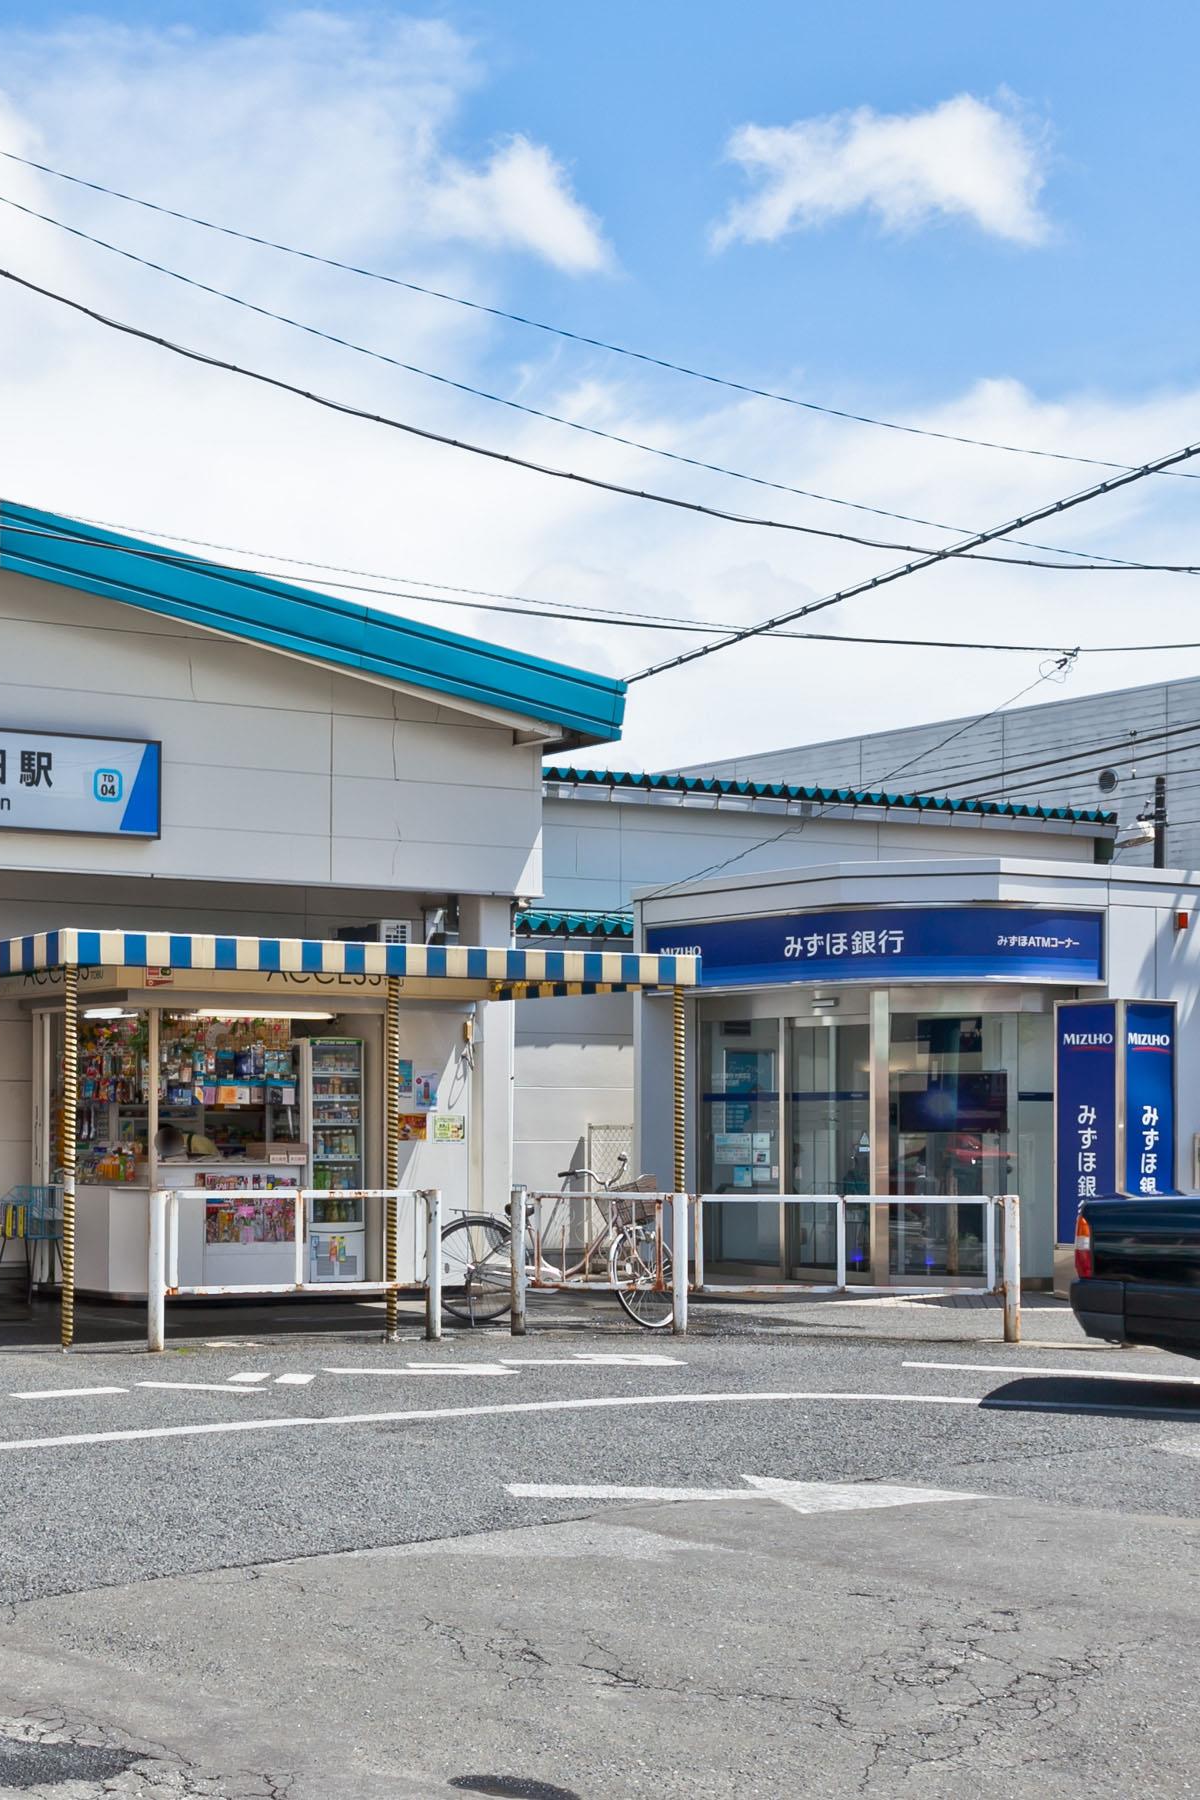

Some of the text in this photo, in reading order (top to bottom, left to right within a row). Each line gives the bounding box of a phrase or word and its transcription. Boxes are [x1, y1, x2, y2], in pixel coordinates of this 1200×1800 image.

[102, 774, 114, 783] TD
[100, 784, 116, 798] 04
[784, 929, 905, 958] みずほ銀行
[997, 934, 1080, 949] みずほATMコーナー
[1063, 1033, 1113, 1045] MIZUHO
[1128, 1032, 1170, 1046] MIZUHO
[1077, 1105, 1098, 1213] みずほ銀
